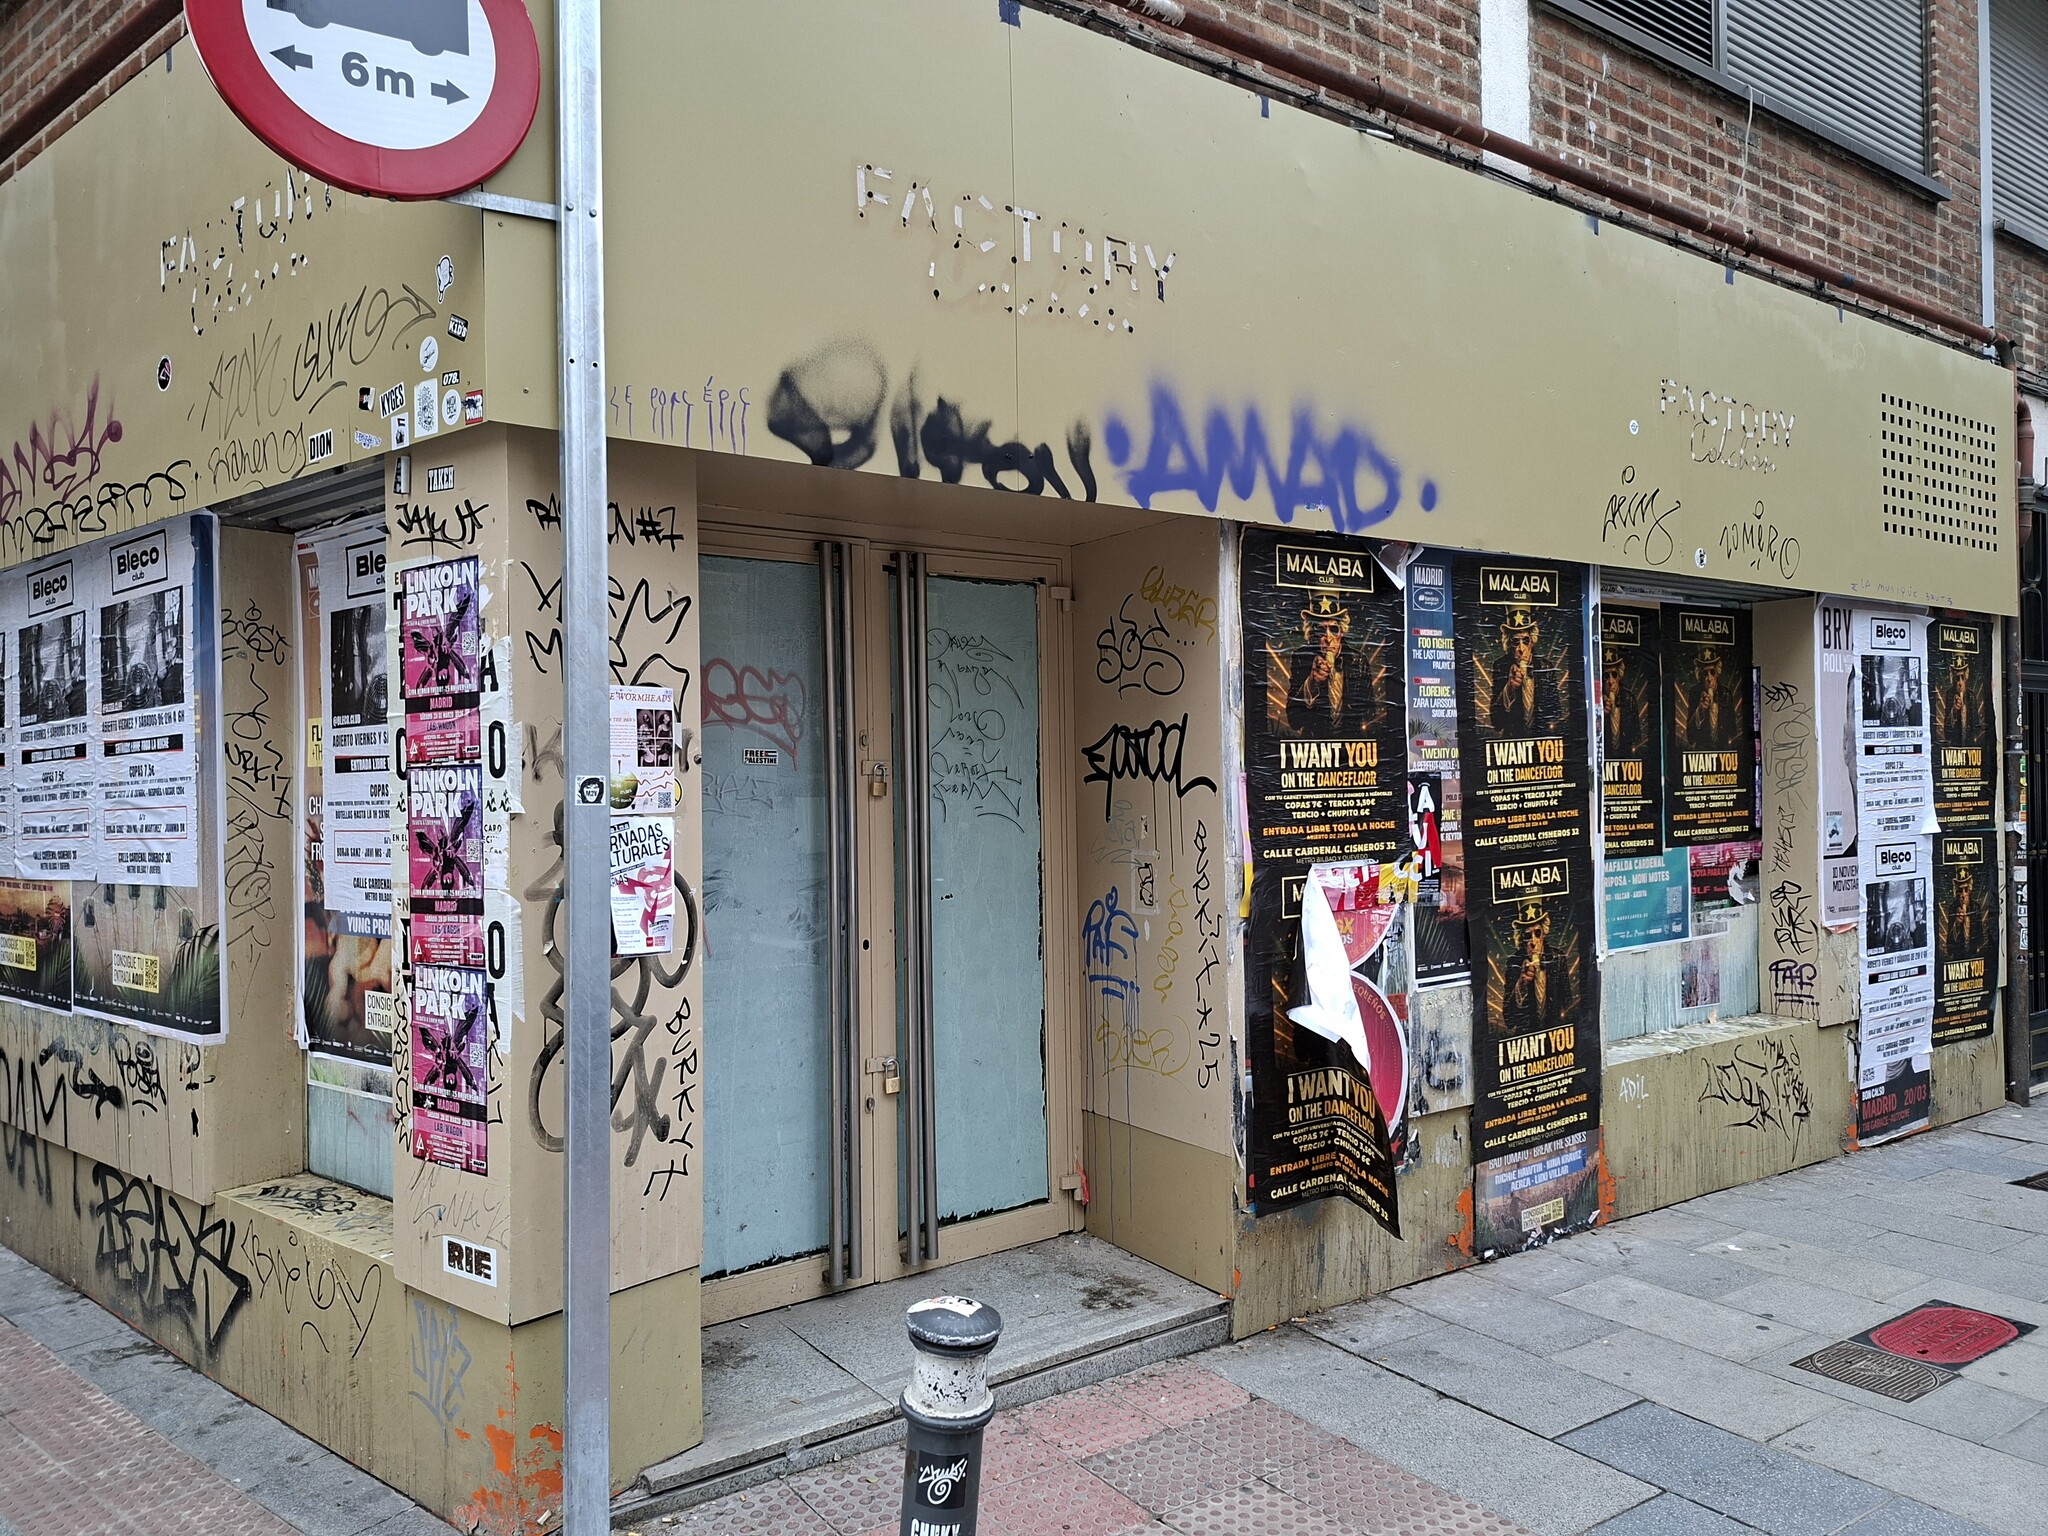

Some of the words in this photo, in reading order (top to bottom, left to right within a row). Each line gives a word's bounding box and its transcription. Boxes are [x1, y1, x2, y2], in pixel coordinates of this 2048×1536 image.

[381, 384, 404, 417] KYGES
[1660, 379, 1796, 448] FACTORY
[310, 432, 332, 460] DION
[117, 546, 160, 575] Bleco
[356, 550, 386, 578] Ble
[1286, 553, 1364, 578] MALABA
[132, 570, 145, 582] club
[406, 561, 475, 596] LINKOLN
[1319, 576, 1334, 584] CLUB
[1414, 567, 1443, 586] MADRID
[1489, 574, 1550, 592] MALABA
[33, 574, 68, 600] Bleco
[406, 588, 458, 625] PARK
[1686, 618, 1729, 634] MALABA
[1876, 624, 1906, 639] Bleco
[1418, 638, 1432, 649] FOO
[1943, 629, 1975, 645] MALABA
[1412, 650, 1422, 659] THE
[1423, 650, 1435, 659] LAST
[1823, 653, 1844, 673] ROLL
[616, 692, 672, 703] WORMHEADS
[1419, 686, 1450, 697] FLORENCE
[430, 697, 453, 710] MADRID
[1413, 698, 1429, 708] ZARA
[1430, 698, 1456, 708] LARSSON
[333, 734, 353, 747] ABIERTO
[354, 732, 376, 746] VIERNES
[1280, 743, 1286, 769] I
[1291, 743, 1342, 768] WANT
[1345, 743, 1378, 768] YOU
[1421, 748, 1450, 759] TWENTY
[1486, 744, 1491, 766] I
[1494, 741, 1534, 765] WANT
[1537, 740, 1563, 763] YOU
[1945, 749, 1966, 766] WANT
[1967, 749, 1982, 765] YOU
[1622, 762, 1642, 781] YOU
[1683, 754, 1687, 773] I
[1688, 754, 1718, 772] WANT
[1720, 753, 1738, 771] YOU
[411, 769, 479, 797] LINKOLN
[1281, 773, 1296, 788] ON
[1298, 773, 1316, 788] THE
[1317, 771, 1377, 787] DANCEFLOOR
[1487, 771, 1498, 783] ON
[1500, 770, 1514, 782] THE
[1515, 766, 1563, 781] DANCEFLOOR
[1683, 775, 1692, 786] ON
[1693, 775, 1703, 786] THE
[1703, 774, 1737, 785] DANCEFLOOR
[370, 784, 389, 797] COPAS
[411, 792, 462, 824] PARK
[1285, 801, 1310, 809] COPAS
[1329, 799, 1354, 807] TERCIO
[1292, 811, 1319, 819] TERCIO
[1327, 809, 1358, 817] CHUPITO
[610, 823, 663, 851] RNADAS
[1263, 826, 1304, 836] ENTRADA
[1306, 824, 1330, 834] LIBRE
[1332, 823, 1355, 832] TODA
[1357, 822, 1368, 830] LA
[1369, 821, 1395, 830] NOCHE
[1264, 849, 1292, 858] CALLE
[1295, 846, 1342, 856] CARDENAL
[1344, 843, 1384, 854] CISNEROS
[1386, 842, 1396, 850] 32
[1881, 850, 1911, 865] Bleco
[1946, 842, 1979, 856] MALABA
[1634, 857, 1665, 869] CARDENAL
[353, 877, 367, 888] CALLE
[1500, 866, 1561, 889] MALABA
[1649, 870, 1670, 883] MOTES
[347, 917, 369, 934] YUNG
[1948, 963, 1969, 981] WANT
[1970, 961, 1985, 978] YOU
[415, 967, 484, 1004] LINKOLN
[415, 989, 466, 1026] PARK
[1499, 1043, 1504, 1066] I
[1508, 1034, 1546, 1062] WANT
[1549, 1027, 1574, 1053] YOU
[1500, 1067, 1511, 1083] ON
[1512, 1063, 1526, 1080] THE
[1527, 1052, 1574, 1076] DANCEFLOOR
[1288, 1077, 1294, 1103] I
[1298, 1070, 1349, 1101] WANT
[1351, 1080, 1375, 1118] YOU
[1862, 1093, 1897, 1120] MADRID
[1904, 1083, 1927, 1106] 20/03
[437, 1098, 460, 1114] MADRID
[1289, 1106, 1302, 1122] ON
[1304, 1102, 1322, 1120] THE
[1325, 1100, 1374, 1138] DANCEFLOOR
[1293, 1133, 1317, 1144] COPAS
[1270, 1160, 1309, 1176] ENTRADA
[1312, 1153, 1336, 1164] LIBRE
[1357, 1167, 1367, 1180] LA
[1495, 1171, 1516, 1185] RICHIE
[1518, 1165, 1542, 1180] HAWTIN
[1271, 1184, 1297, 1199] CALLE
[1300, 1173, 1348, 1190] CARDENAL
[447, 1240, 491, 1280] RIE
